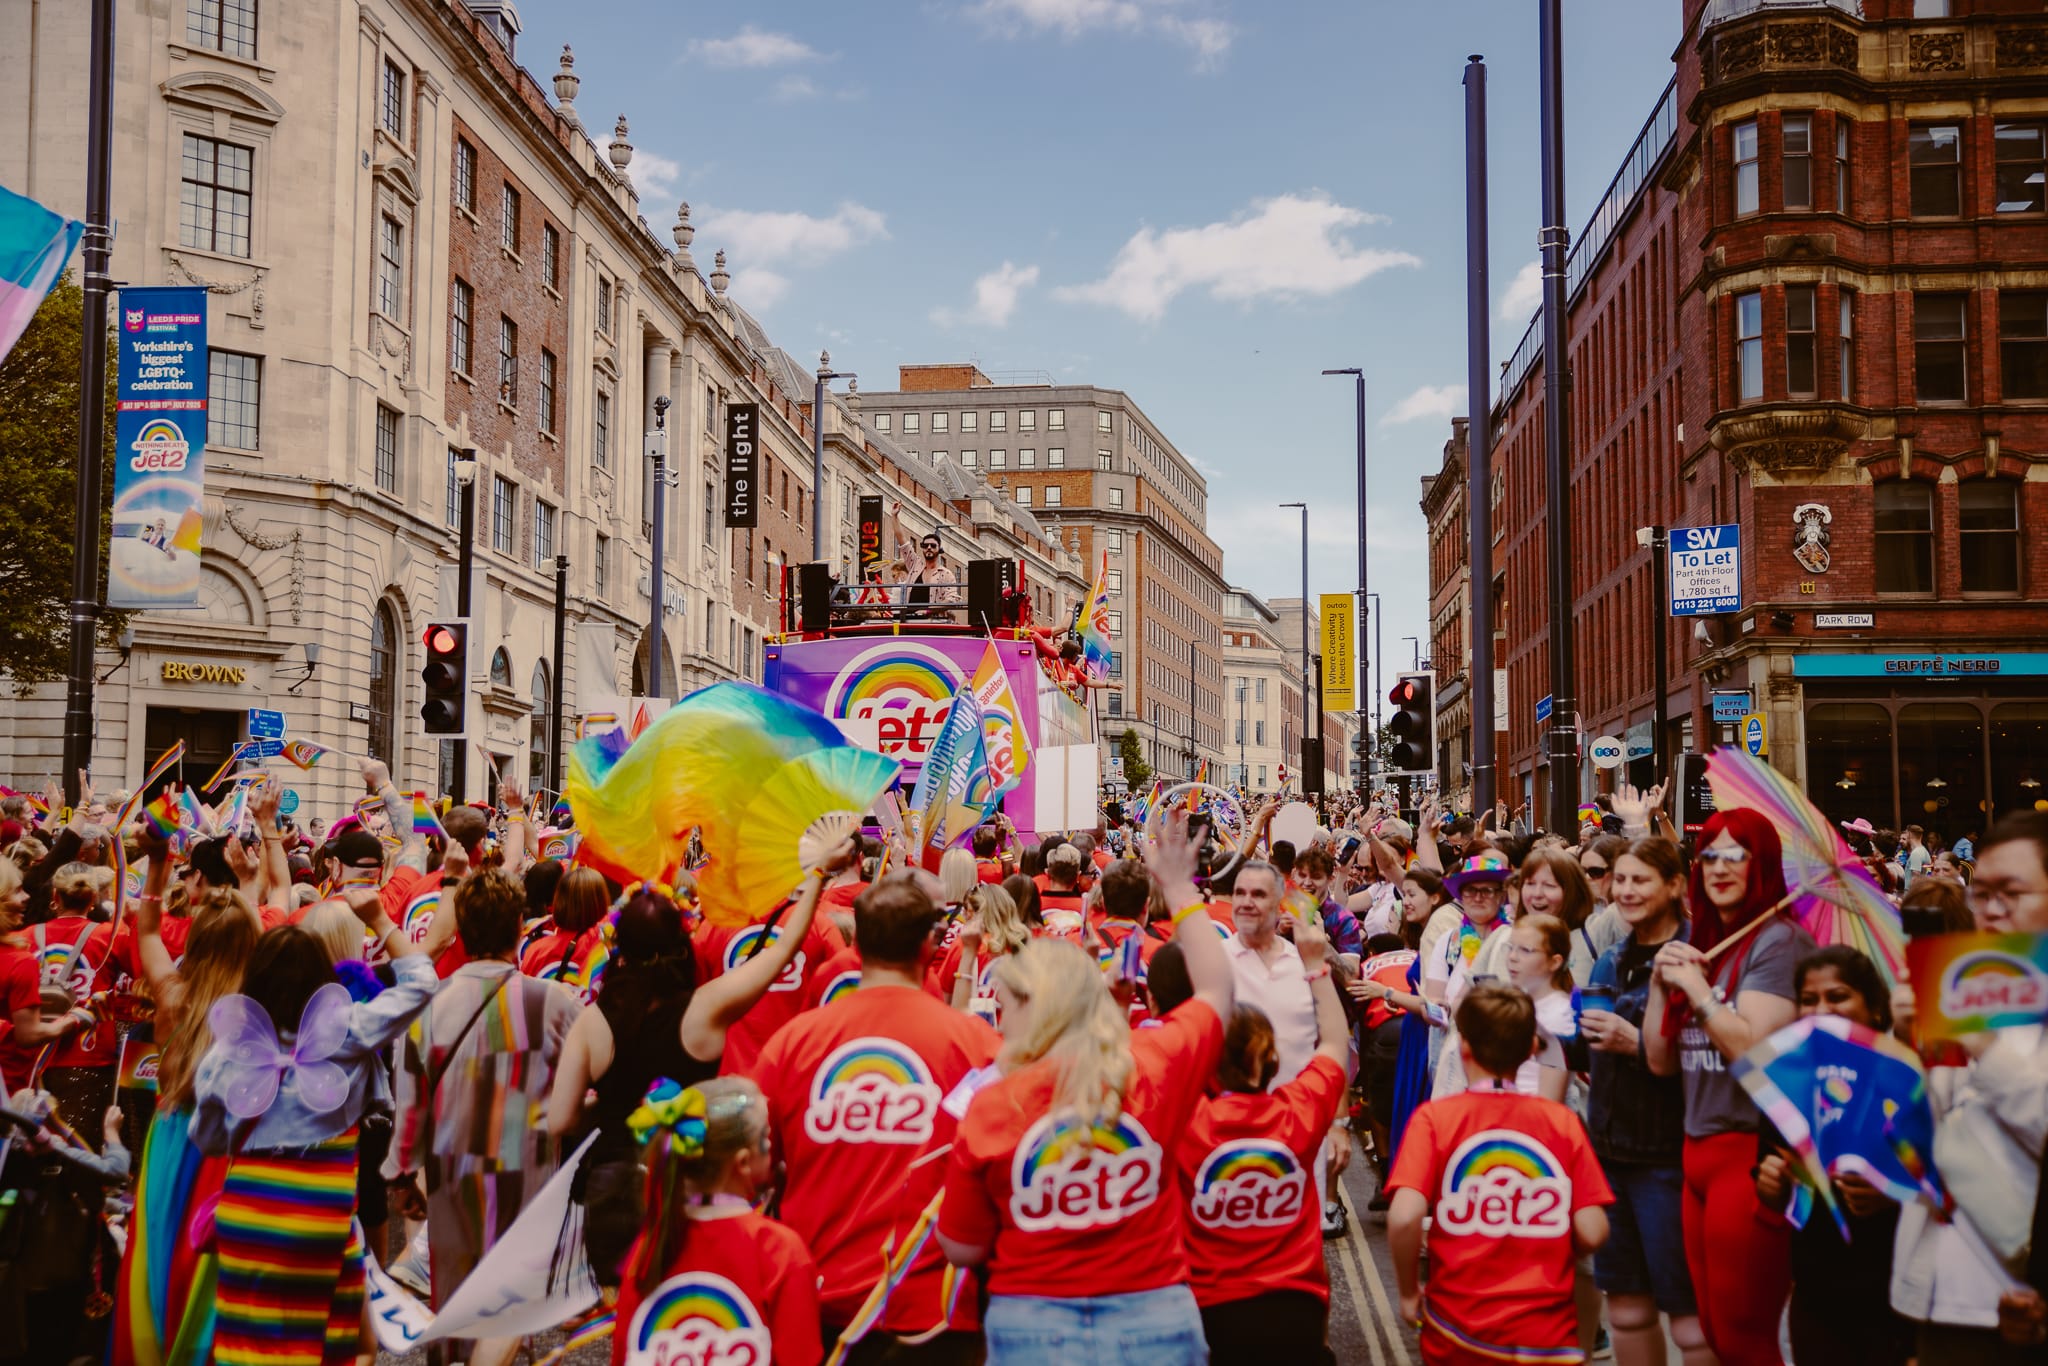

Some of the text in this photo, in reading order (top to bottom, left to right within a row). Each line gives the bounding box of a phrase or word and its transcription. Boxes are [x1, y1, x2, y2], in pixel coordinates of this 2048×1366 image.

[132, 341, 194, 352] Yorkshire's
[141, 354, 184, 366] biggest
[138, 367, 186, 378] LGBTQ+
[131, 380, 194, 390] celebration
[731, 412, 752, 518] the light
[862, 521, 879, 562] vue
[1686, 527, 1722, 549] SW
[1679, 551, 1731, 568] To Let
[1675, 567, 1735, 578] Part 4th Floor
[1690, 578, 1721, 586] Offices
[1681, 585, 1731, 598] 1,780 sq ft
[1674, 597, 1738, 609] 0113 221 6000
[1818, 615, 1870, 624] PARK ROW
[1328, 613, 1337, 685] Where Creativity
[1338, 642, 1346, 654] the
[1947, 659, 2000, 672] NERO
[162, 661, 247, 684] BROWNS
[1715, 708, 1749, 716] NERO
[1595, 747, 1620, 757] TSB
